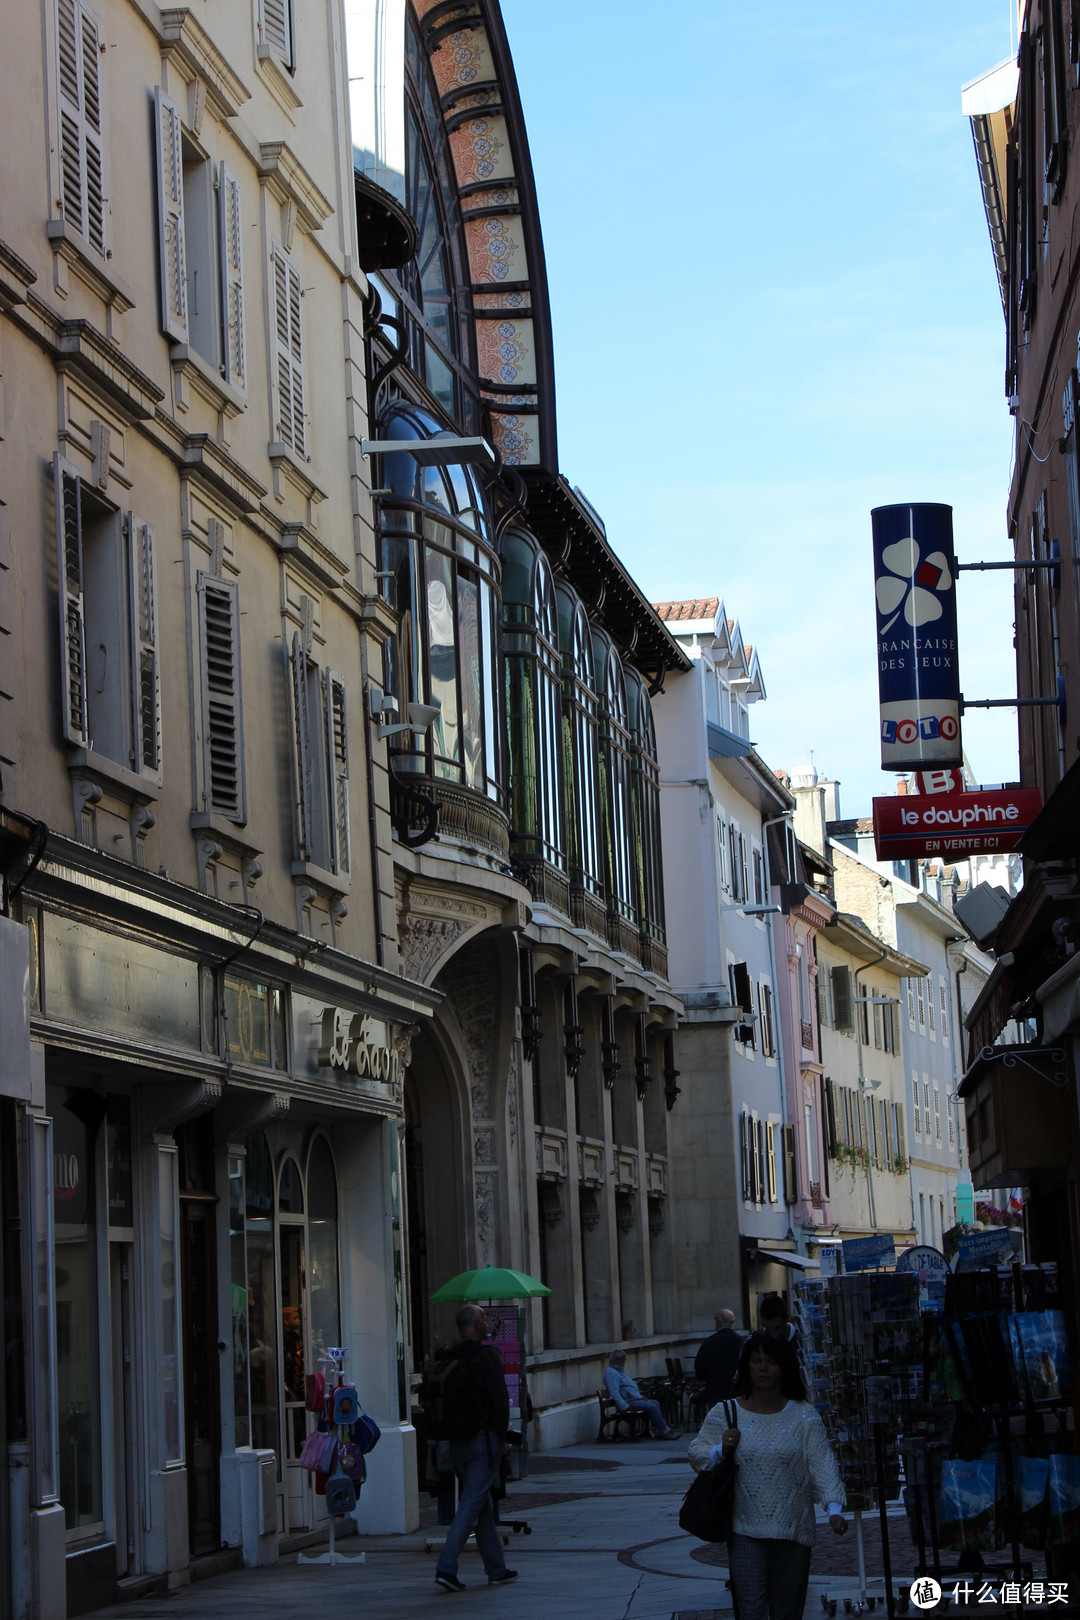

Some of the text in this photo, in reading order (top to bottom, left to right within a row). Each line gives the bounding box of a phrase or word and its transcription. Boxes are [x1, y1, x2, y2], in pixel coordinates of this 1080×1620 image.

[881, 657, 951, 671] DES JEUX
[881, 717, 957, 742] LOTO
[901, 804, 1019, 827] le dauphiné
[925, 837, 999, 850] EN VENTE ICI
